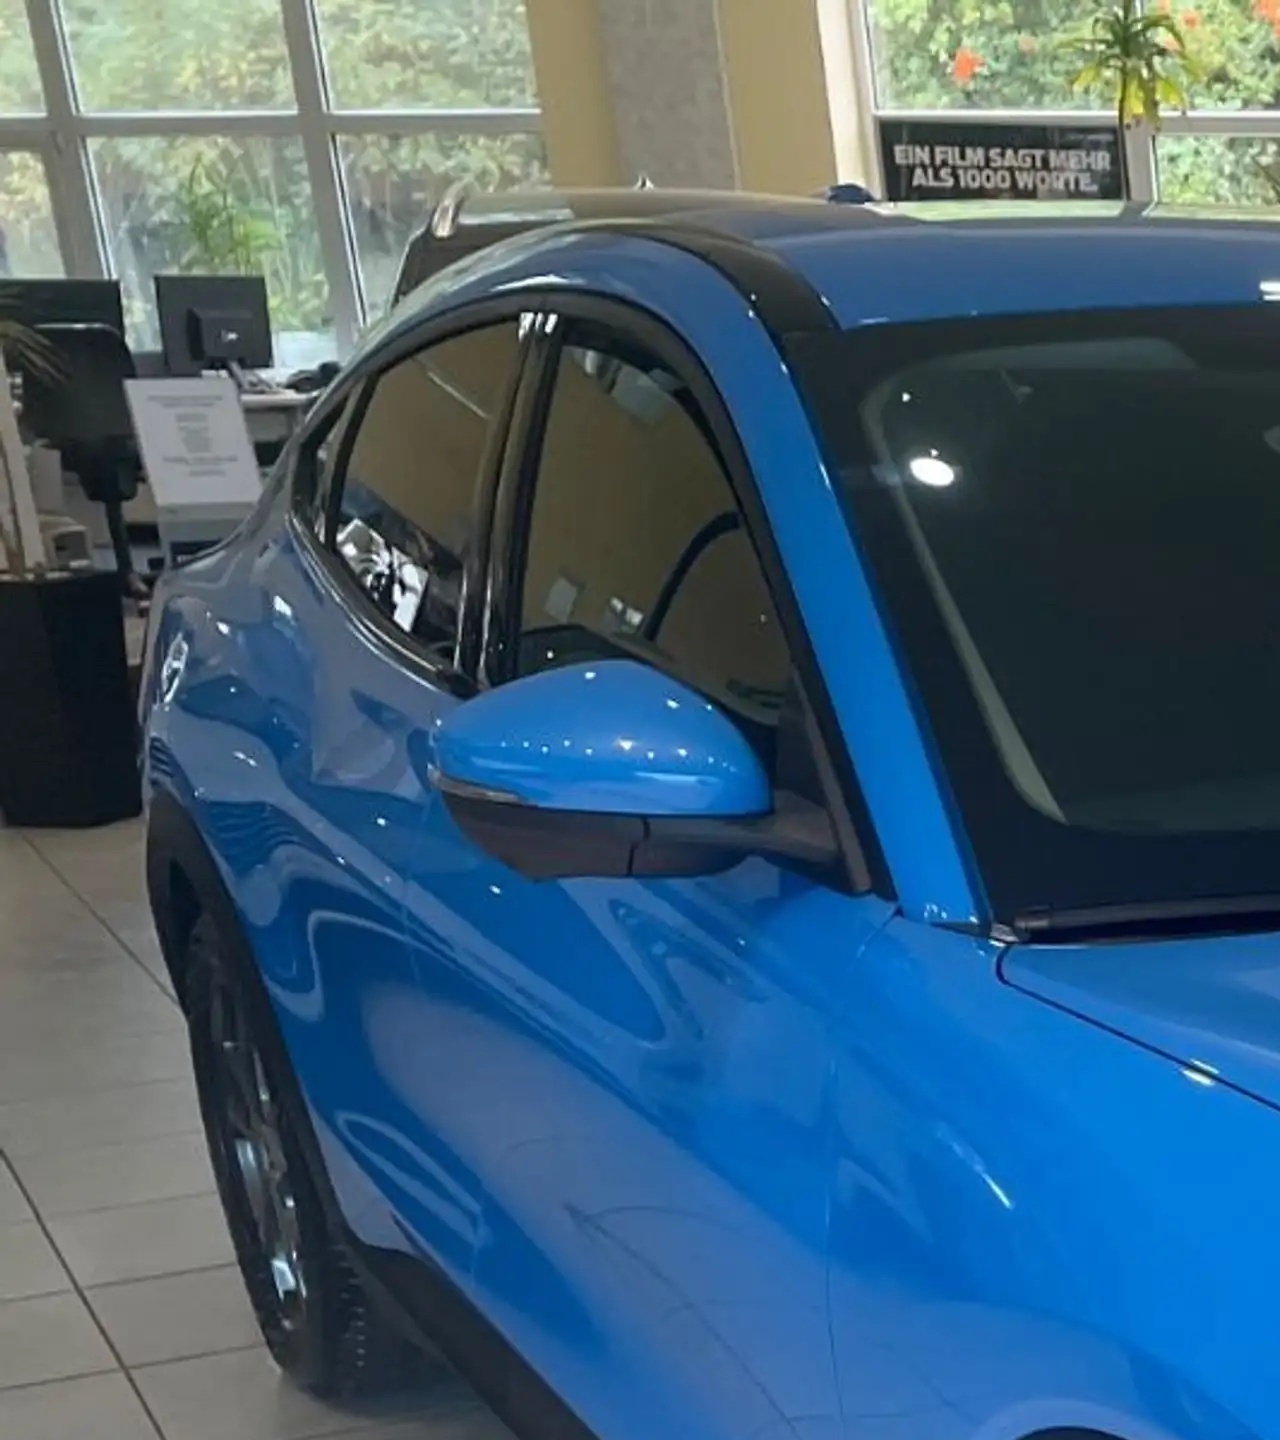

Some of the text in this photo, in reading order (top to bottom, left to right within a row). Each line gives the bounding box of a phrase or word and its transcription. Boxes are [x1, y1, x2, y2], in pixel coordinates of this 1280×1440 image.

[894, 145, 1111, 172] EIN FILM SAGT MEHR
[912, 169, 954, 187] ALS
[957, 170, 1011, 189] 1000
